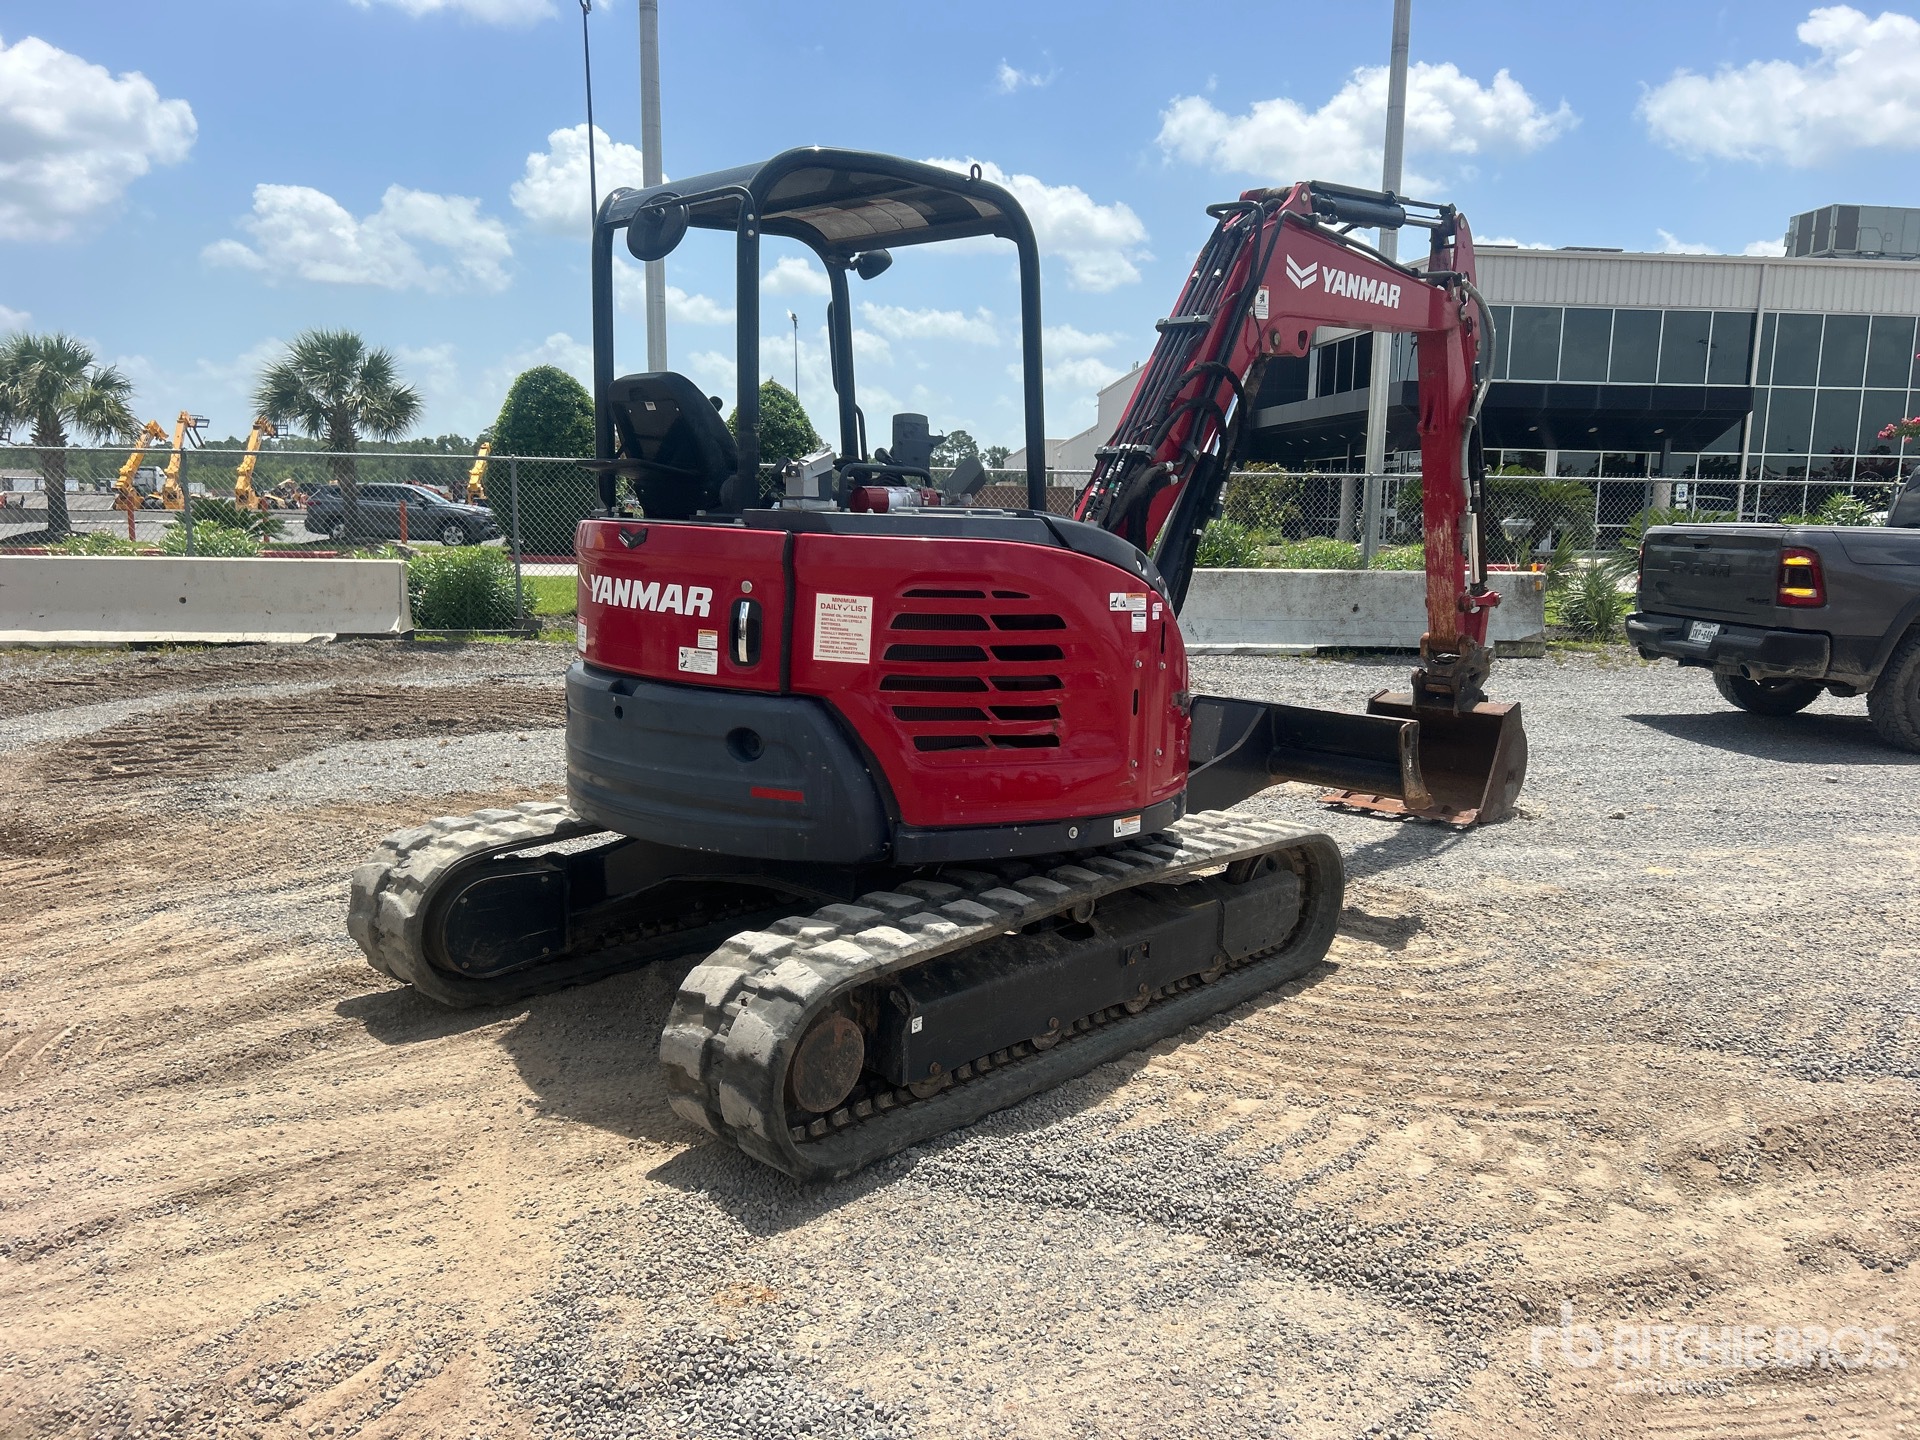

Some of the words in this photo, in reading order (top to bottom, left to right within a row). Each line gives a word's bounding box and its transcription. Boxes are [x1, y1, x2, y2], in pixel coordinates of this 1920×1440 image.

[1322, 266, 1401, 309] YANMAR
[1669, 561, 1730, 577] RAM
[590, 574, 713, 618] YANMAR
